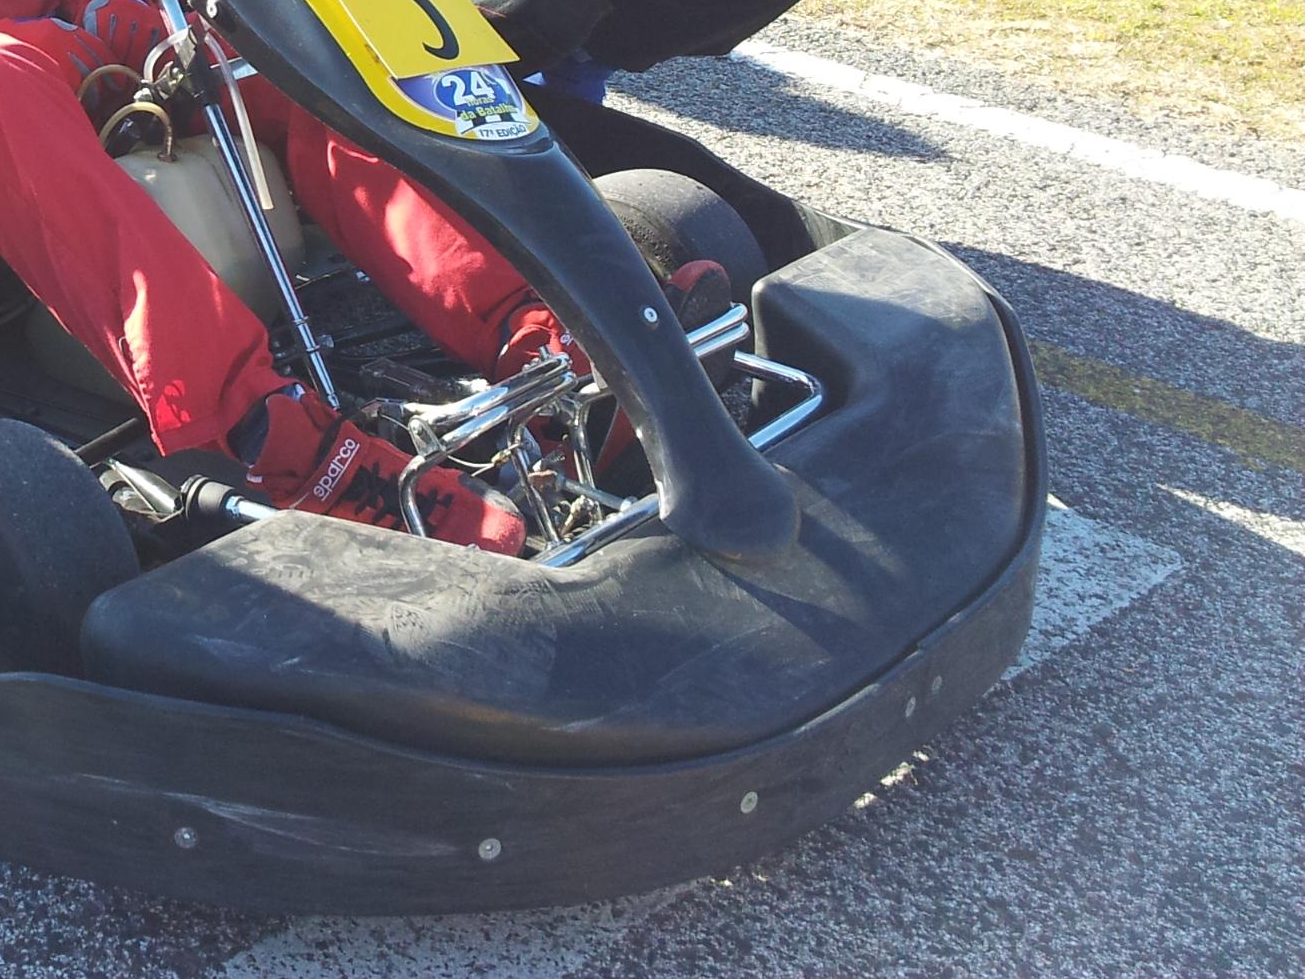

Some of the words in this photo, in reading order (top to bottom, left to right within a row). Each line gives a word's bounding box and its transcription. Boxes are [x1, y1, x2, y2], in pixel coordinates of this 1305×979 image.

[441, 71, 496, 106] 24
[460, 109, 476, 121] da
[313, 438, 358, 498] sparco
